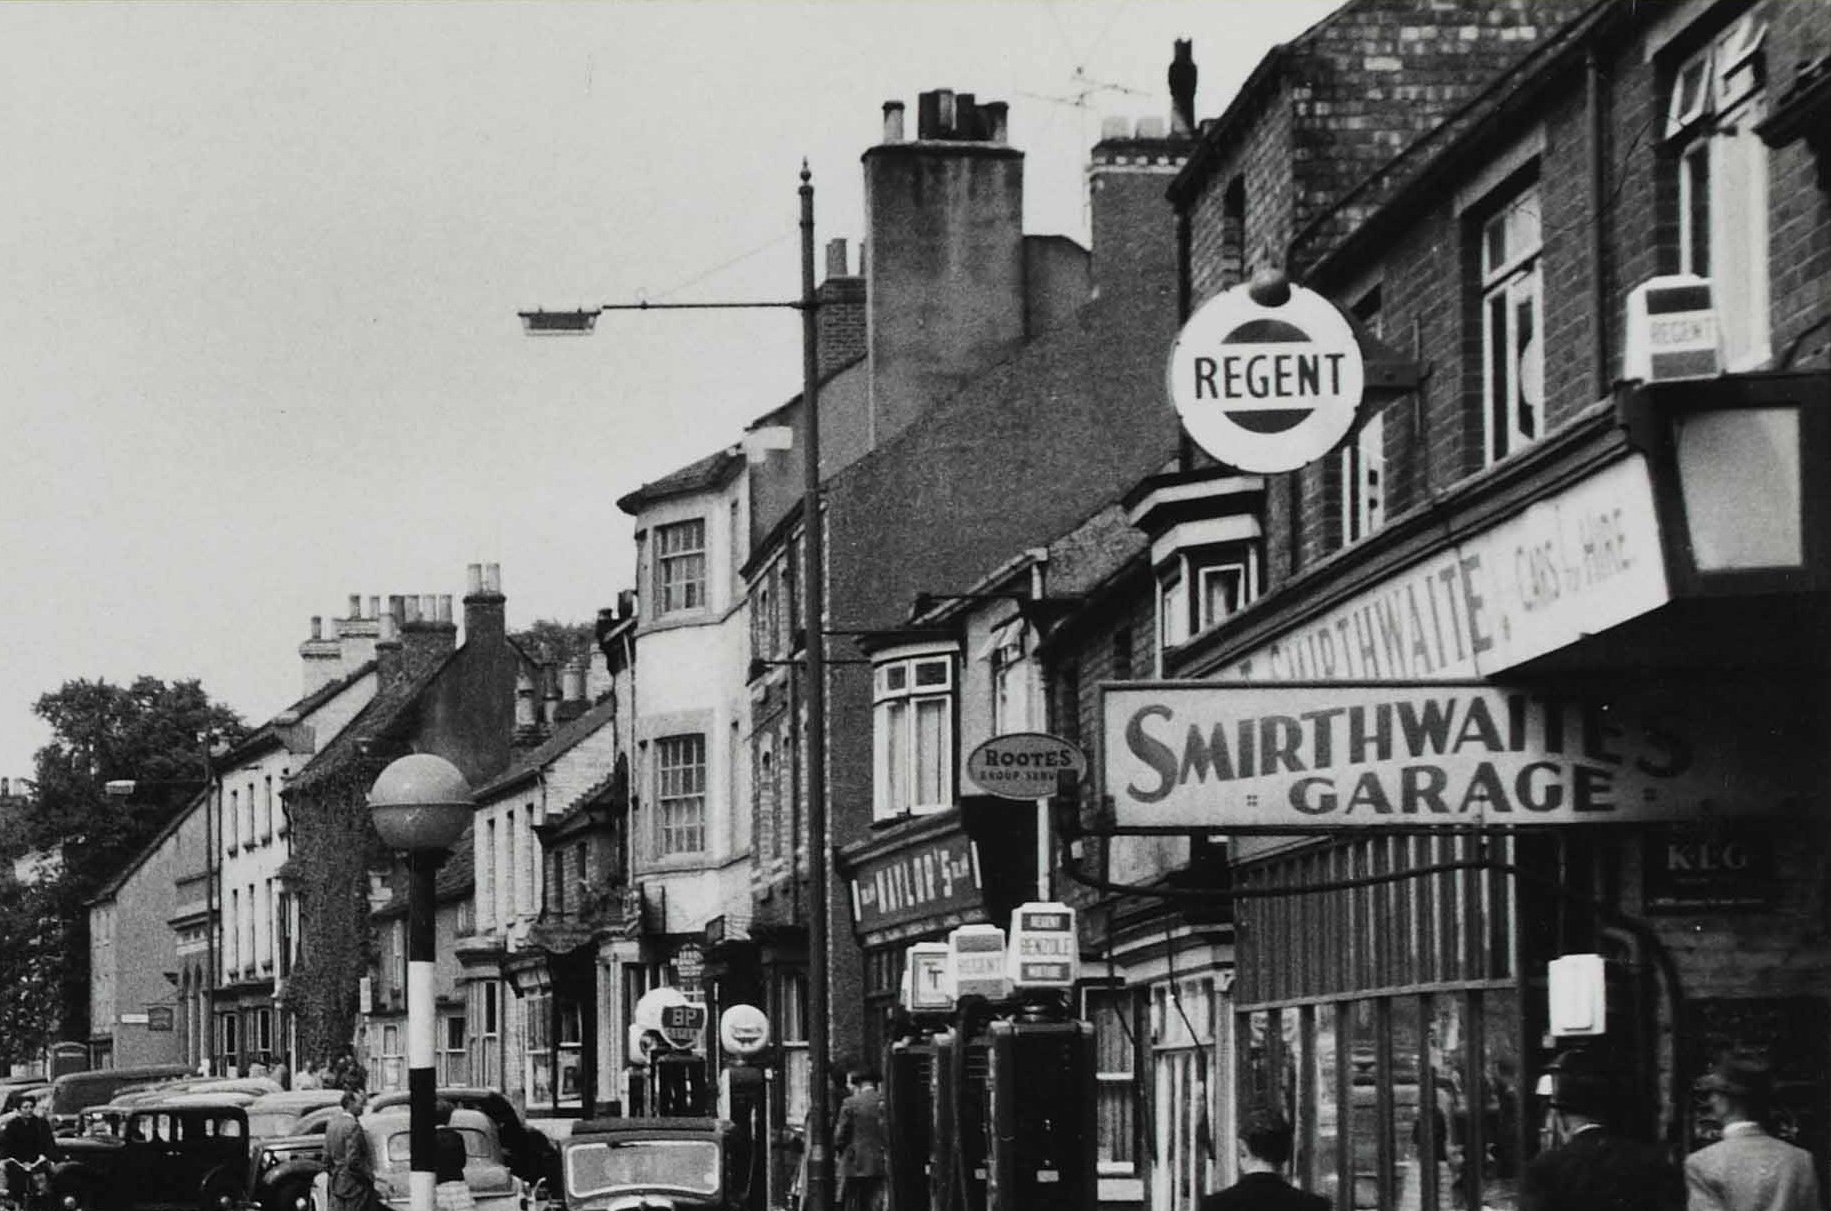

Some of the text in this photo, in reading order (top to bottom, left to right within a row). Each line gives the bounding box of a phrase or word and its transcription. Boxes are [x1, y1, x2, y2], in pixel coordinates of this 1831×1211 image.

[1194, 353, 1346, 400] REGENT
[984, 749, 1072, 767] ROOTES
[1288, 760, 1618, 816] GARAGE
[672, 1009, 697, 1026] BP
